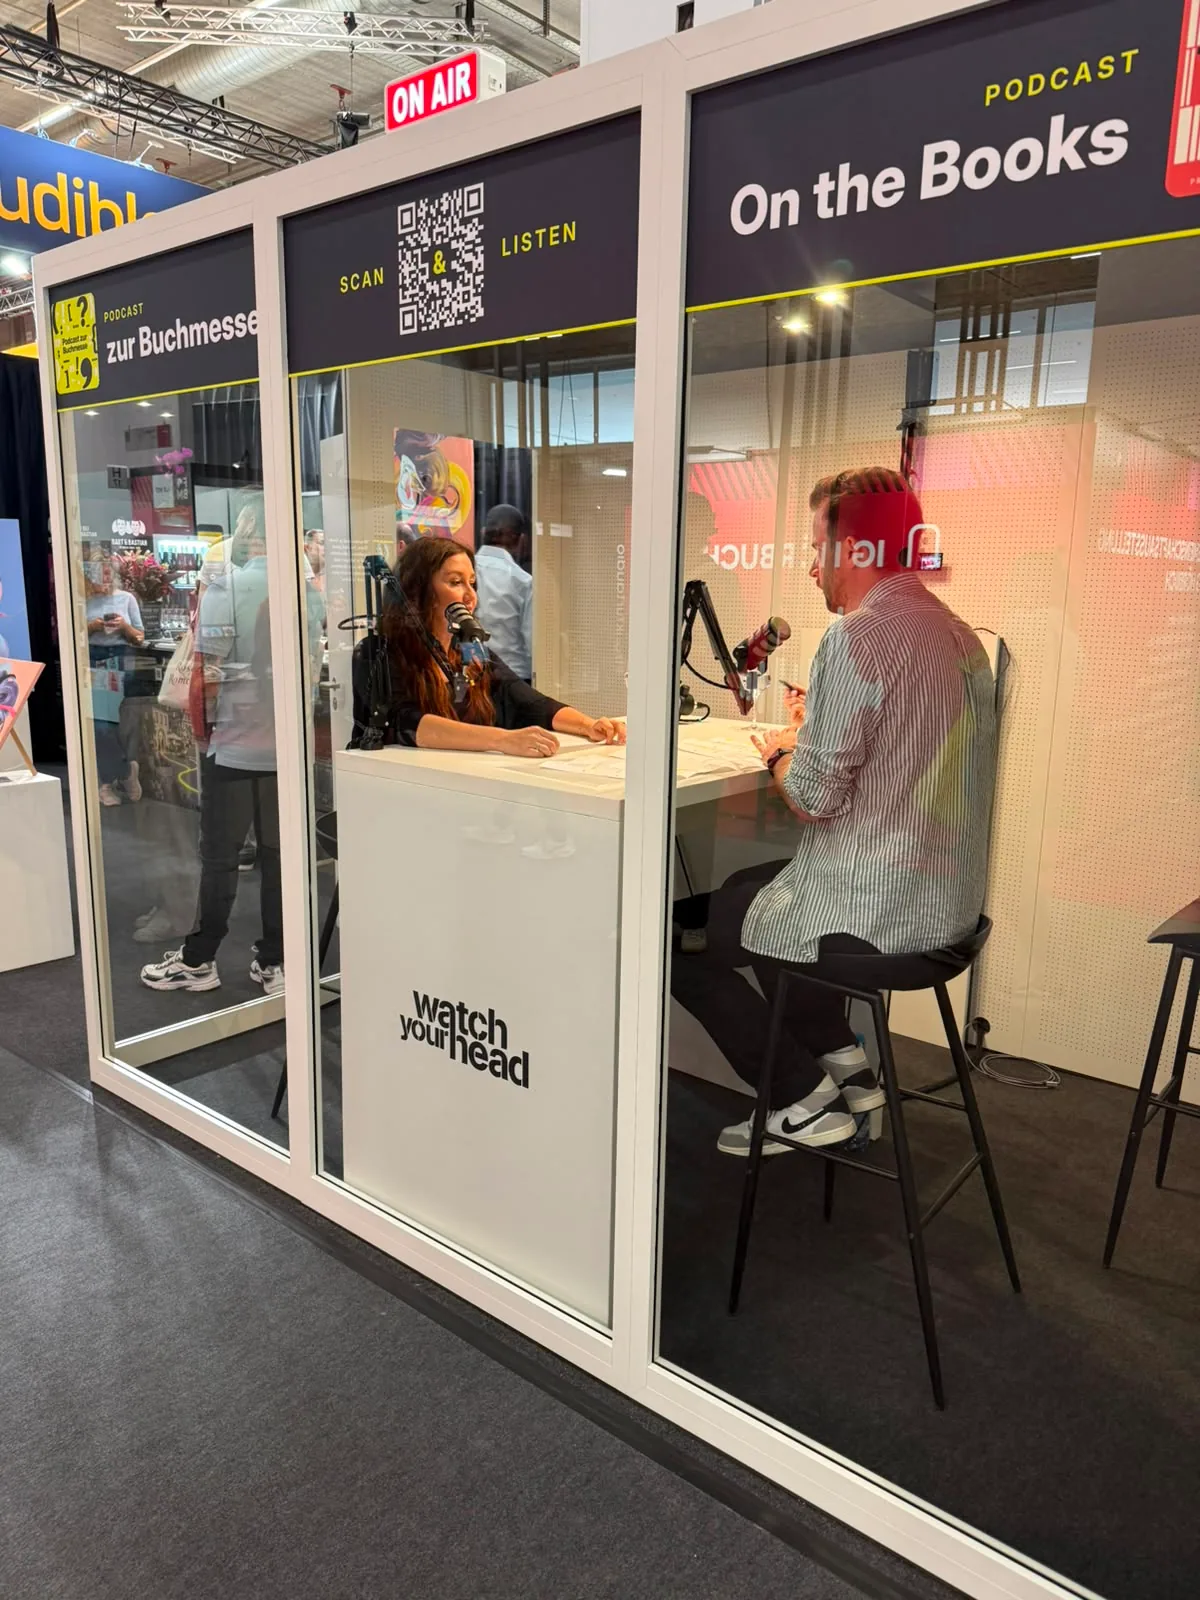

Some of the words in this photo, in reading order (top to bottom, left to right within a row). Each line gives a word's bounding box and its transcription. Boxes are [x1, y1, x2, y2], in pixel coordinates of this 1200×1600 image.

[392, 79, 424, 123] ON
[431, 62, 471, 110] AIR
[985, 49, 1140, 106] PODCAST
[730, 183, 800, 235] On
[813, 162, 905, 219] the
[919, 113, 1129, 200] Books
[0, 172, 156, 238] udibl
[339, 267, 384, 294] SCAN
[432, 249, 447, 275] &
[502, 221, 576, 257] LISTEN
[62, 335, 79, 346] Podcast
[79, 333, 88, 342] zur
[104, 303, 144, 323] PODCAST
[107, 336, 136, 364] zur
[139, 309, 259, 357] Buchmesse
[62, 342, 88, 355] Buchmesse
[413, 990, 508, 1050] watch
[400, 1013, 449, 1050] your
[449, 1018, 529, 1089] head
